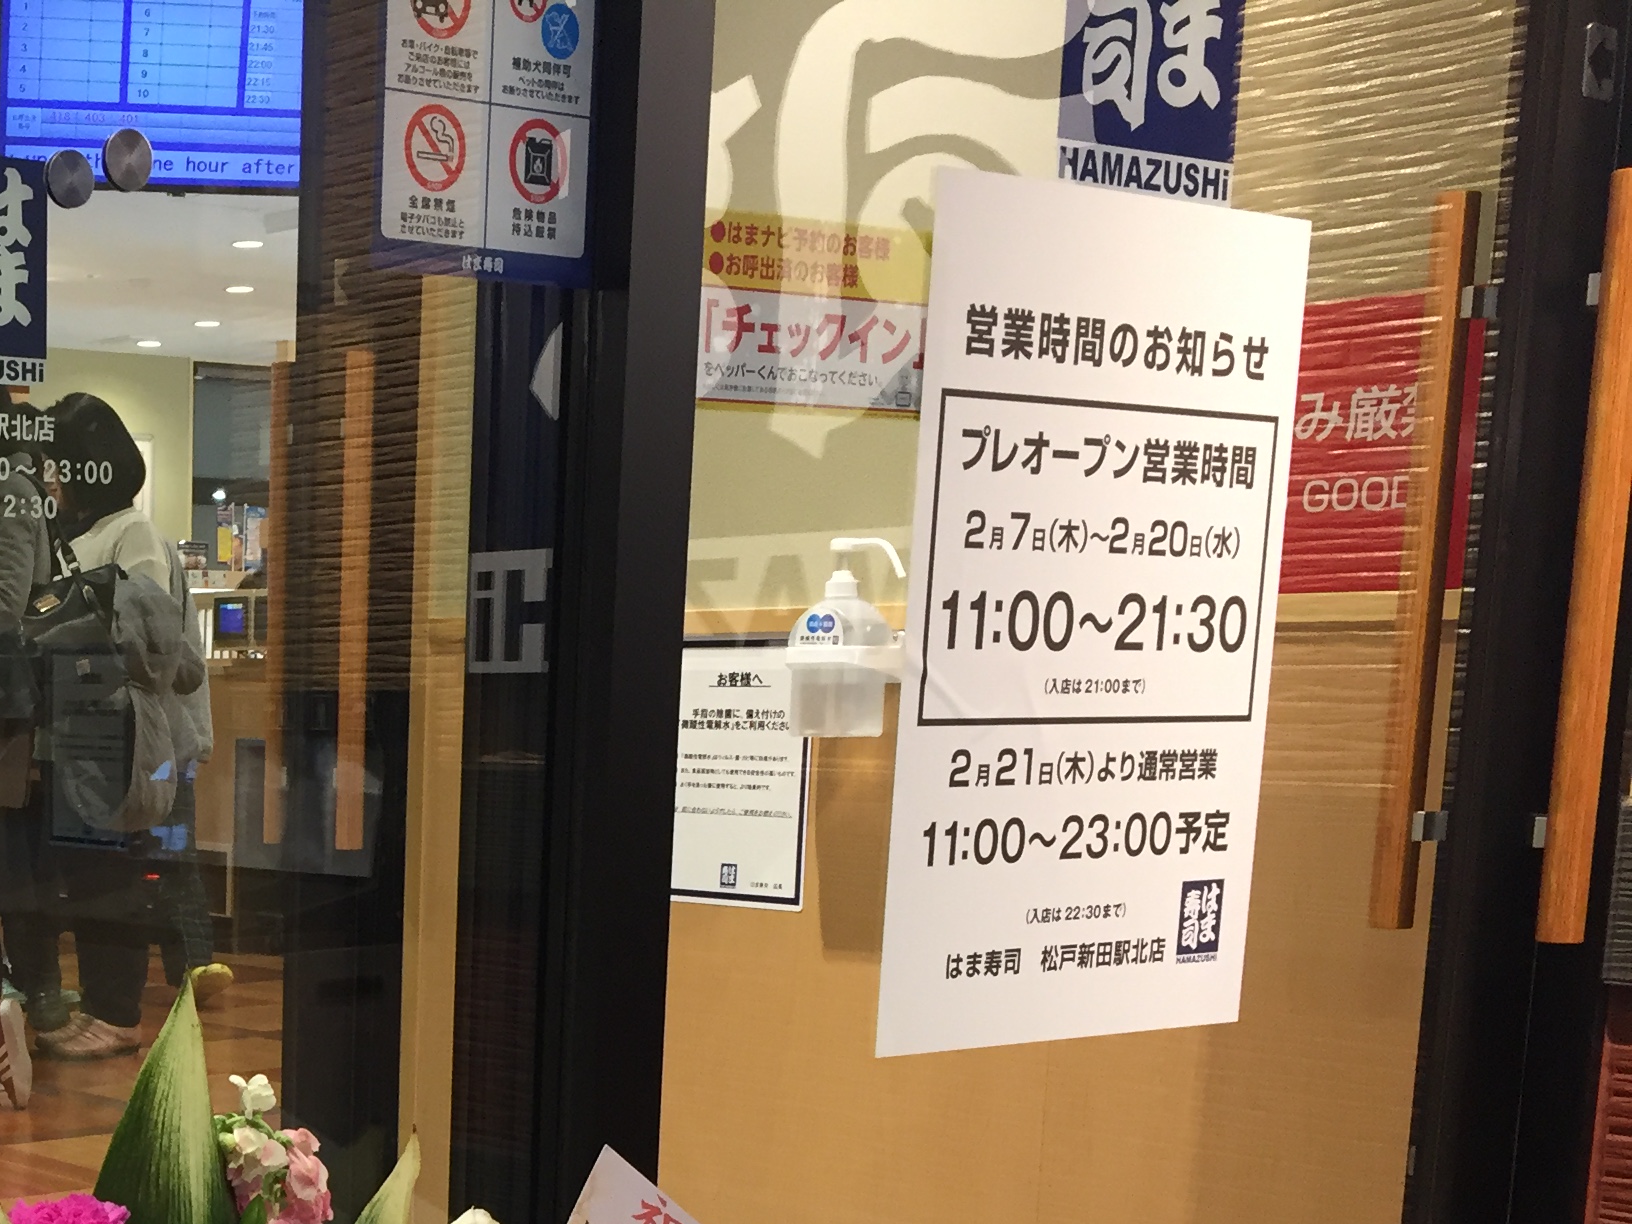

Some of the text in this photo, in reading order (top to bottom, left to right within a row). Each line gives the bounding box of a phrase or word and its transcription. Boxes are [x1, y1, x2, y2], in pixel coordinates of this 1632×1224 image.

[144, 8, 151, 17] 6
[143, 28, 150, 36] 7
[21, 44, 27, 52] 3
[142, 49, 148, 57] 8
[19, 64, 26, 73] 4
[141, 70, 148, 78] 9
[19, 84, 26, 92] 5
[137, 89, 149, 98] 10
[85, 113, 105, 122] 403
[153, 156, 295, 175] ne hour after
[965, 303, 1269, 381] 営業時間のお知らせ
[961, 425, 1258, 490] プレオープン営業時間
[716, 671, 764, 687] お客様へ
[946, 937, 1166, 980] はま寿司 松戸新田駅北店
